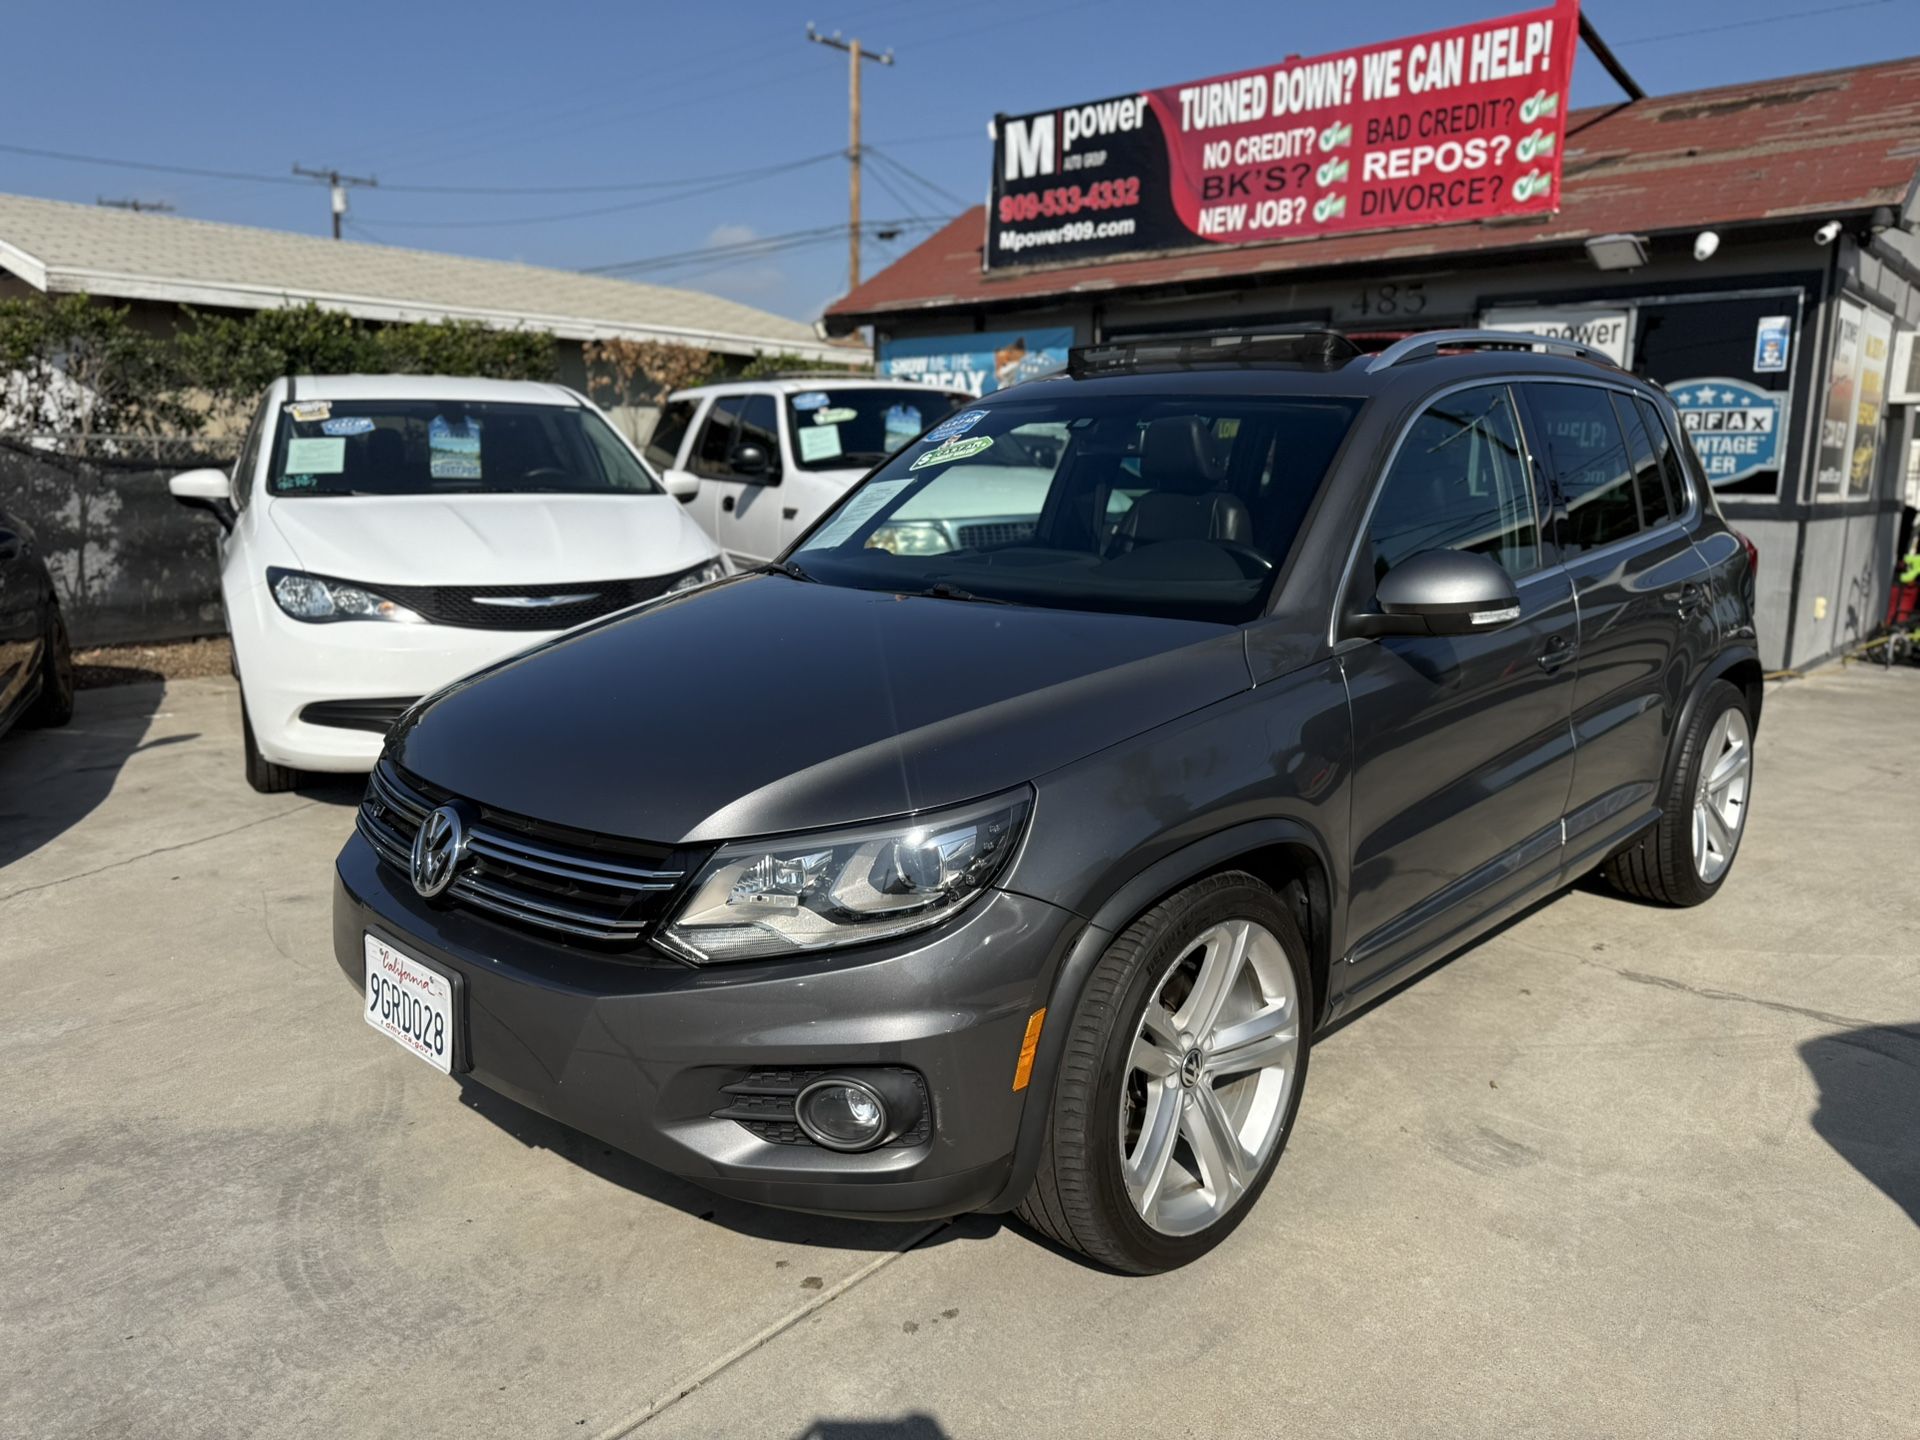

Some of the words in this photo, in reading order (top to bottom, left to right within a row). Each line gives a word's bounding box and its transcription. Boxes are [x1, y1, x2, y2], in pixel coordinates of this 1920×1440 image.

[1179, 75, 1268, 132] TURNED
[1272, 57, 1357, 117] DOWN?
[1363, 49, 1402, 101] WE
[1407, 37, 1464, 94] CAN
[1469, 20, 1553, 83] HELP!
[1005, 114, 1055, 181] M
[1063, 96, 1148, 151] power
[1367, 112, 1411, 145] BAD
[1418, 97, 1515, 138] CREDIT?
[1203, 140, 1231, 170] NO
[1234, 127, 1316, 165] CREDIT?
[1362, 135, 1511, 182] REPOS?
[1000, 176, 1140, 223] 909-533-4332
[1198, 204, 1247, 235] NEW
[1249, 196, 1307, 229] JOB?
[1360, 176, 1503, 216] DIVORCE?
[1000, 218, 1135, 252] Mpower909.com
[1351, 284, 1426, 316] 485
[1684, 411, 1766, 431] RFAX
[382, 951, 435, 996] California
[370, 973, 444, 1056] 9GRD028
[385, 1022, 429, 1053] dmv.ca.gov
